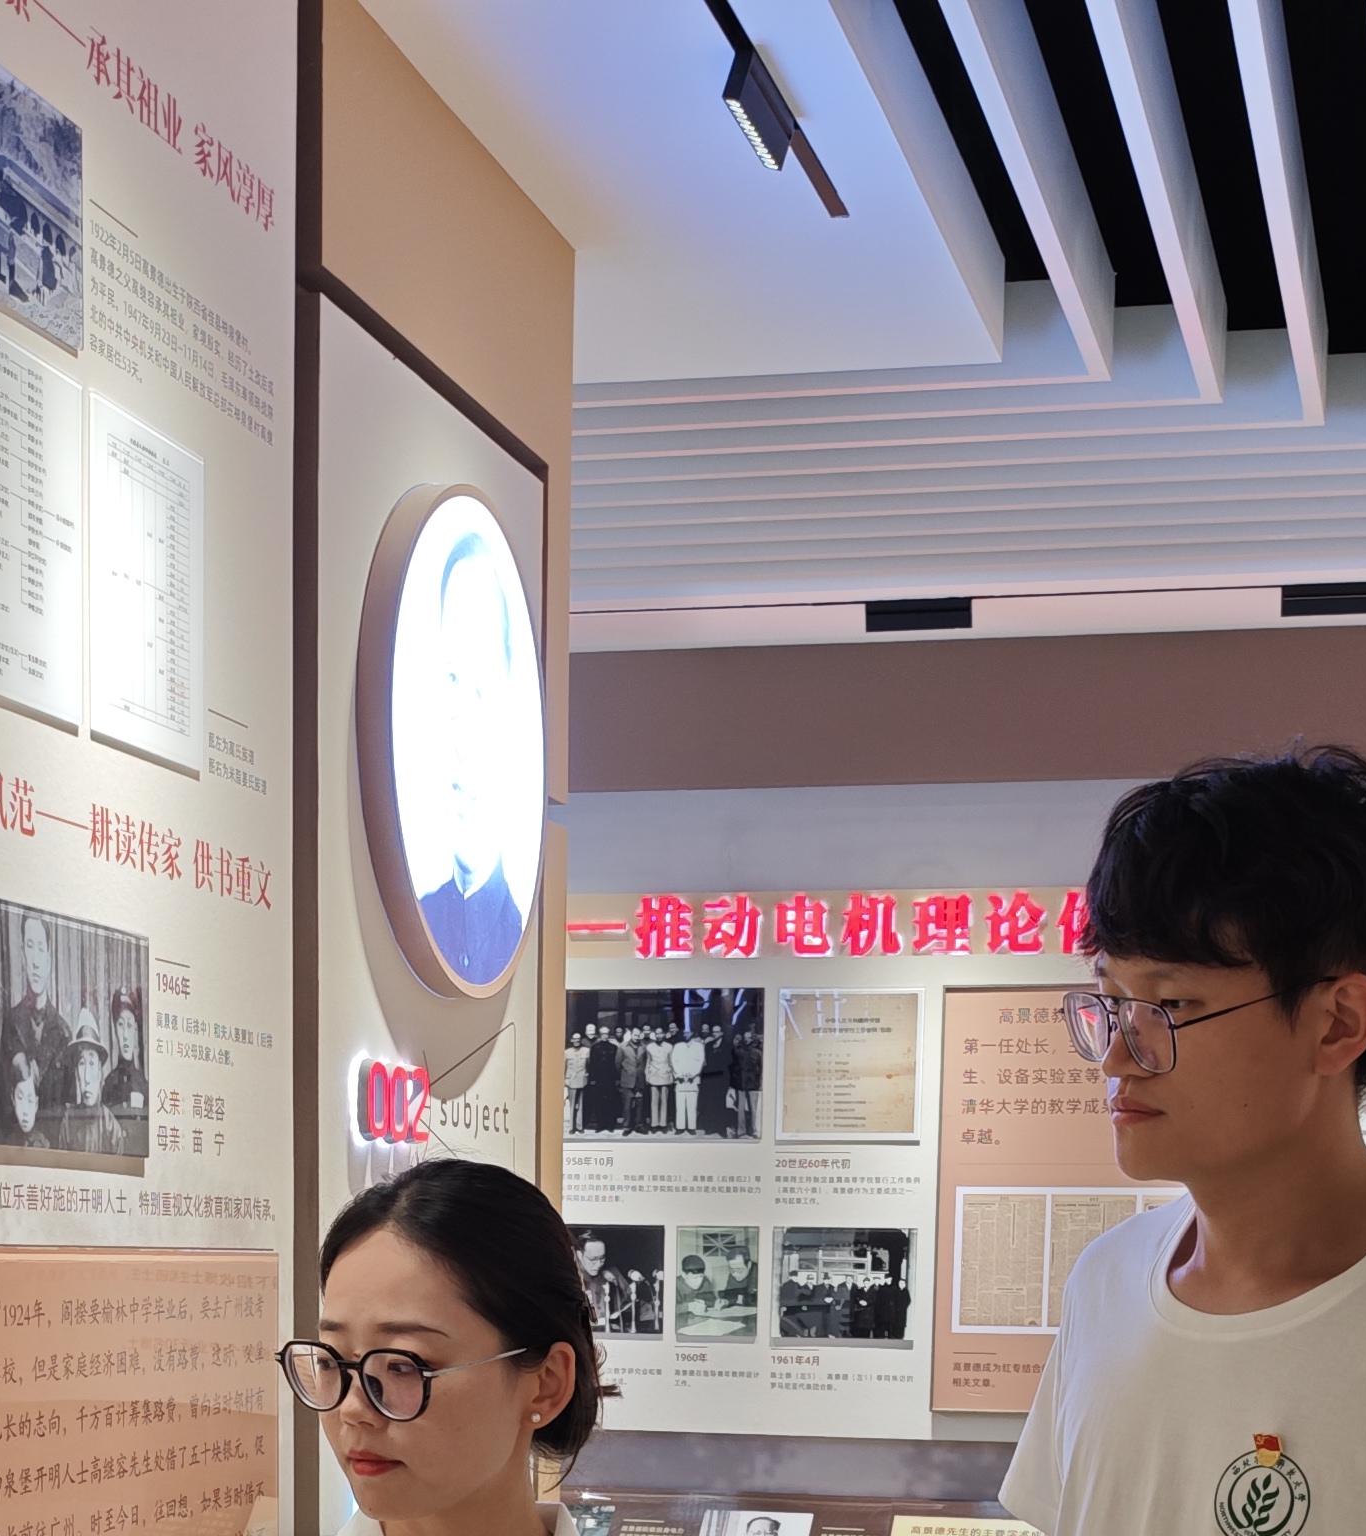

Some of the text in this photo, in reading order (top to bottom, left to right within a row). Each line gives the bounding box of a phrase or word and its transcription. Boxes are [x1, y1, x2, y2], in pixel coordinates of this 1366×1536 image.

[194, 122, 275, 232] 家风淳厚
[192, 838, 274, 912] 供书重文
[156, 972, 191, 1001] 1946年
[962, 1067, 1107, 1086] 生、设备实验室等
[367, 1060, 510, 1144] 002 subject
[959, 1128, 1002, 1146] 卓越。
[565, 1156, 615, 1170] 958年10月
[774, 1157, 852, 1171] 20世纪60年代初
[674, 1352, 709, 1365] 1960年
[770, 1354, 821, 1367] 1961年4月
